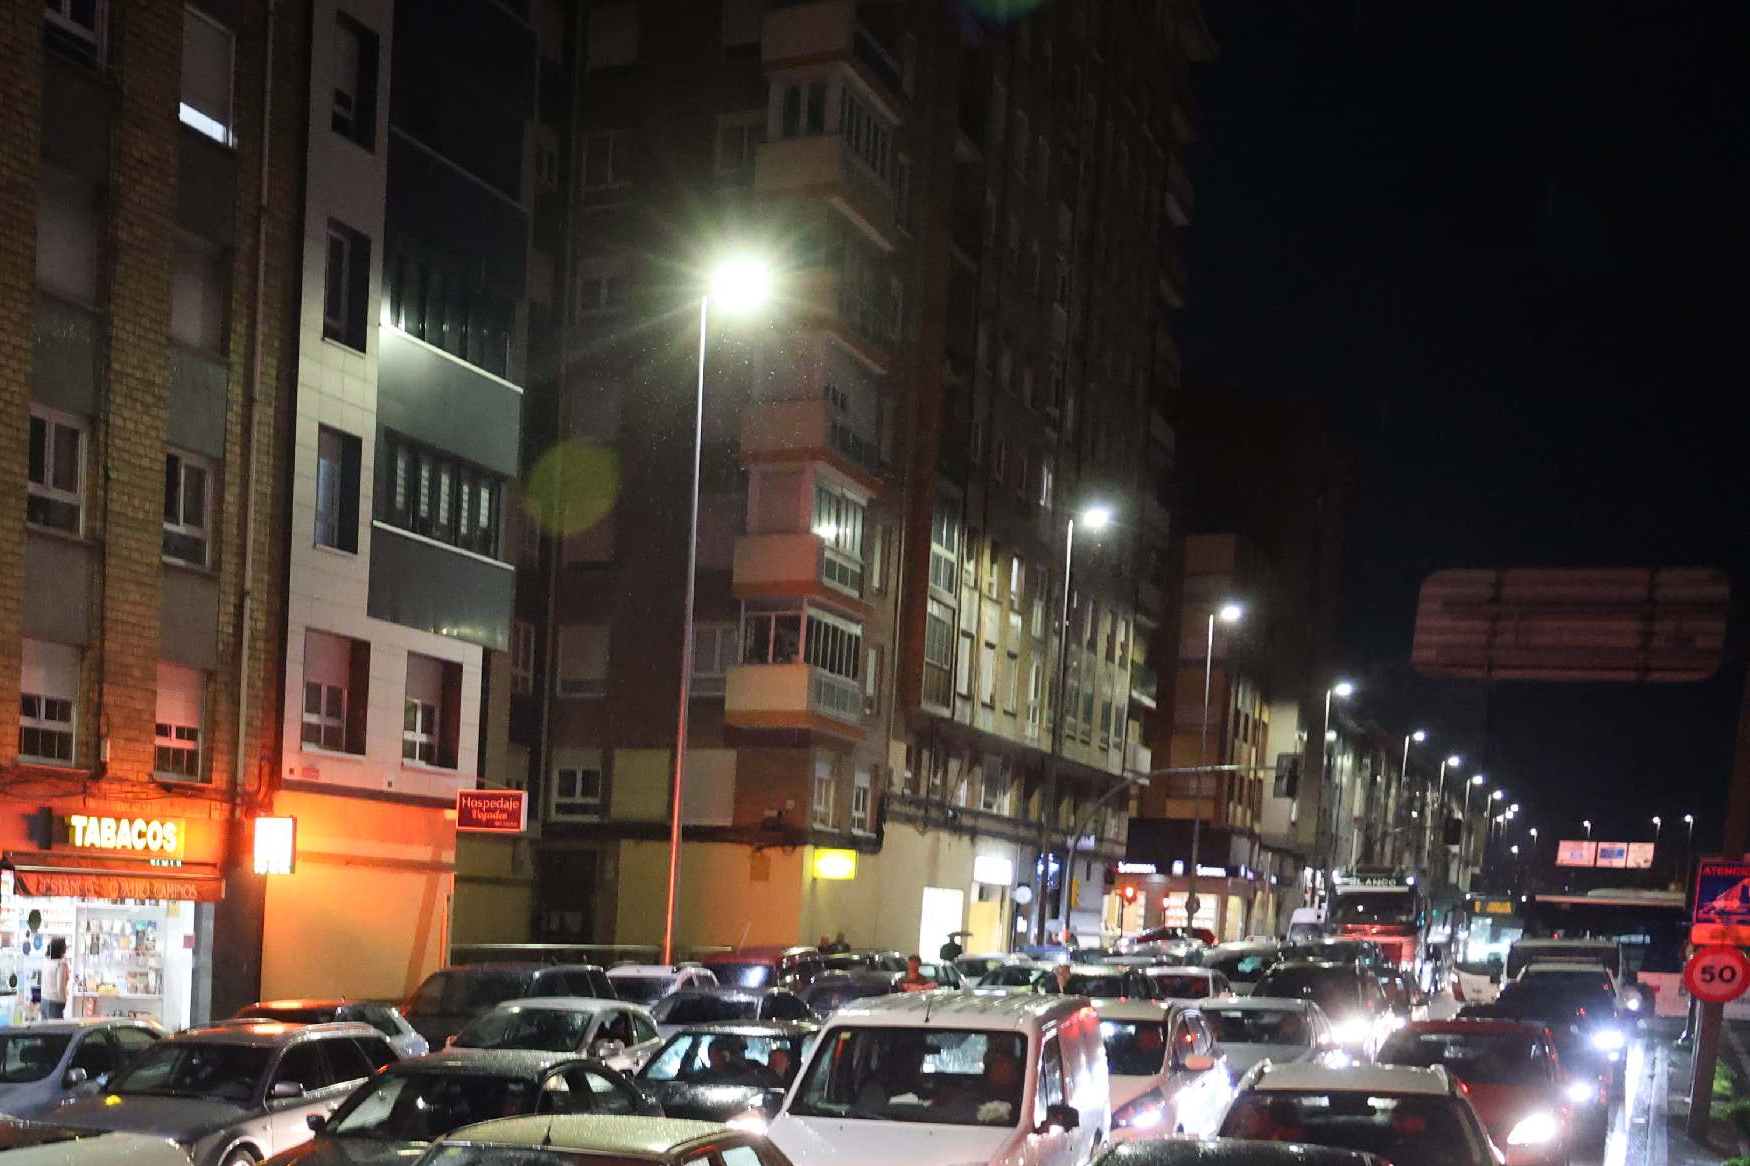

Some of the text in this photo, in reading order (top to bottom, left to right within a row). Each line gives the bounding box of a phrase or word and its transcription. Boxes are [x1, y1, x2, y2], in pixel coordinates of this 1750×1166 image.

[462, 796, 520, 811] Hospedaje
[70, 814, 178, 852] TABACOS
[1701, 965, 1737, 983] 50
